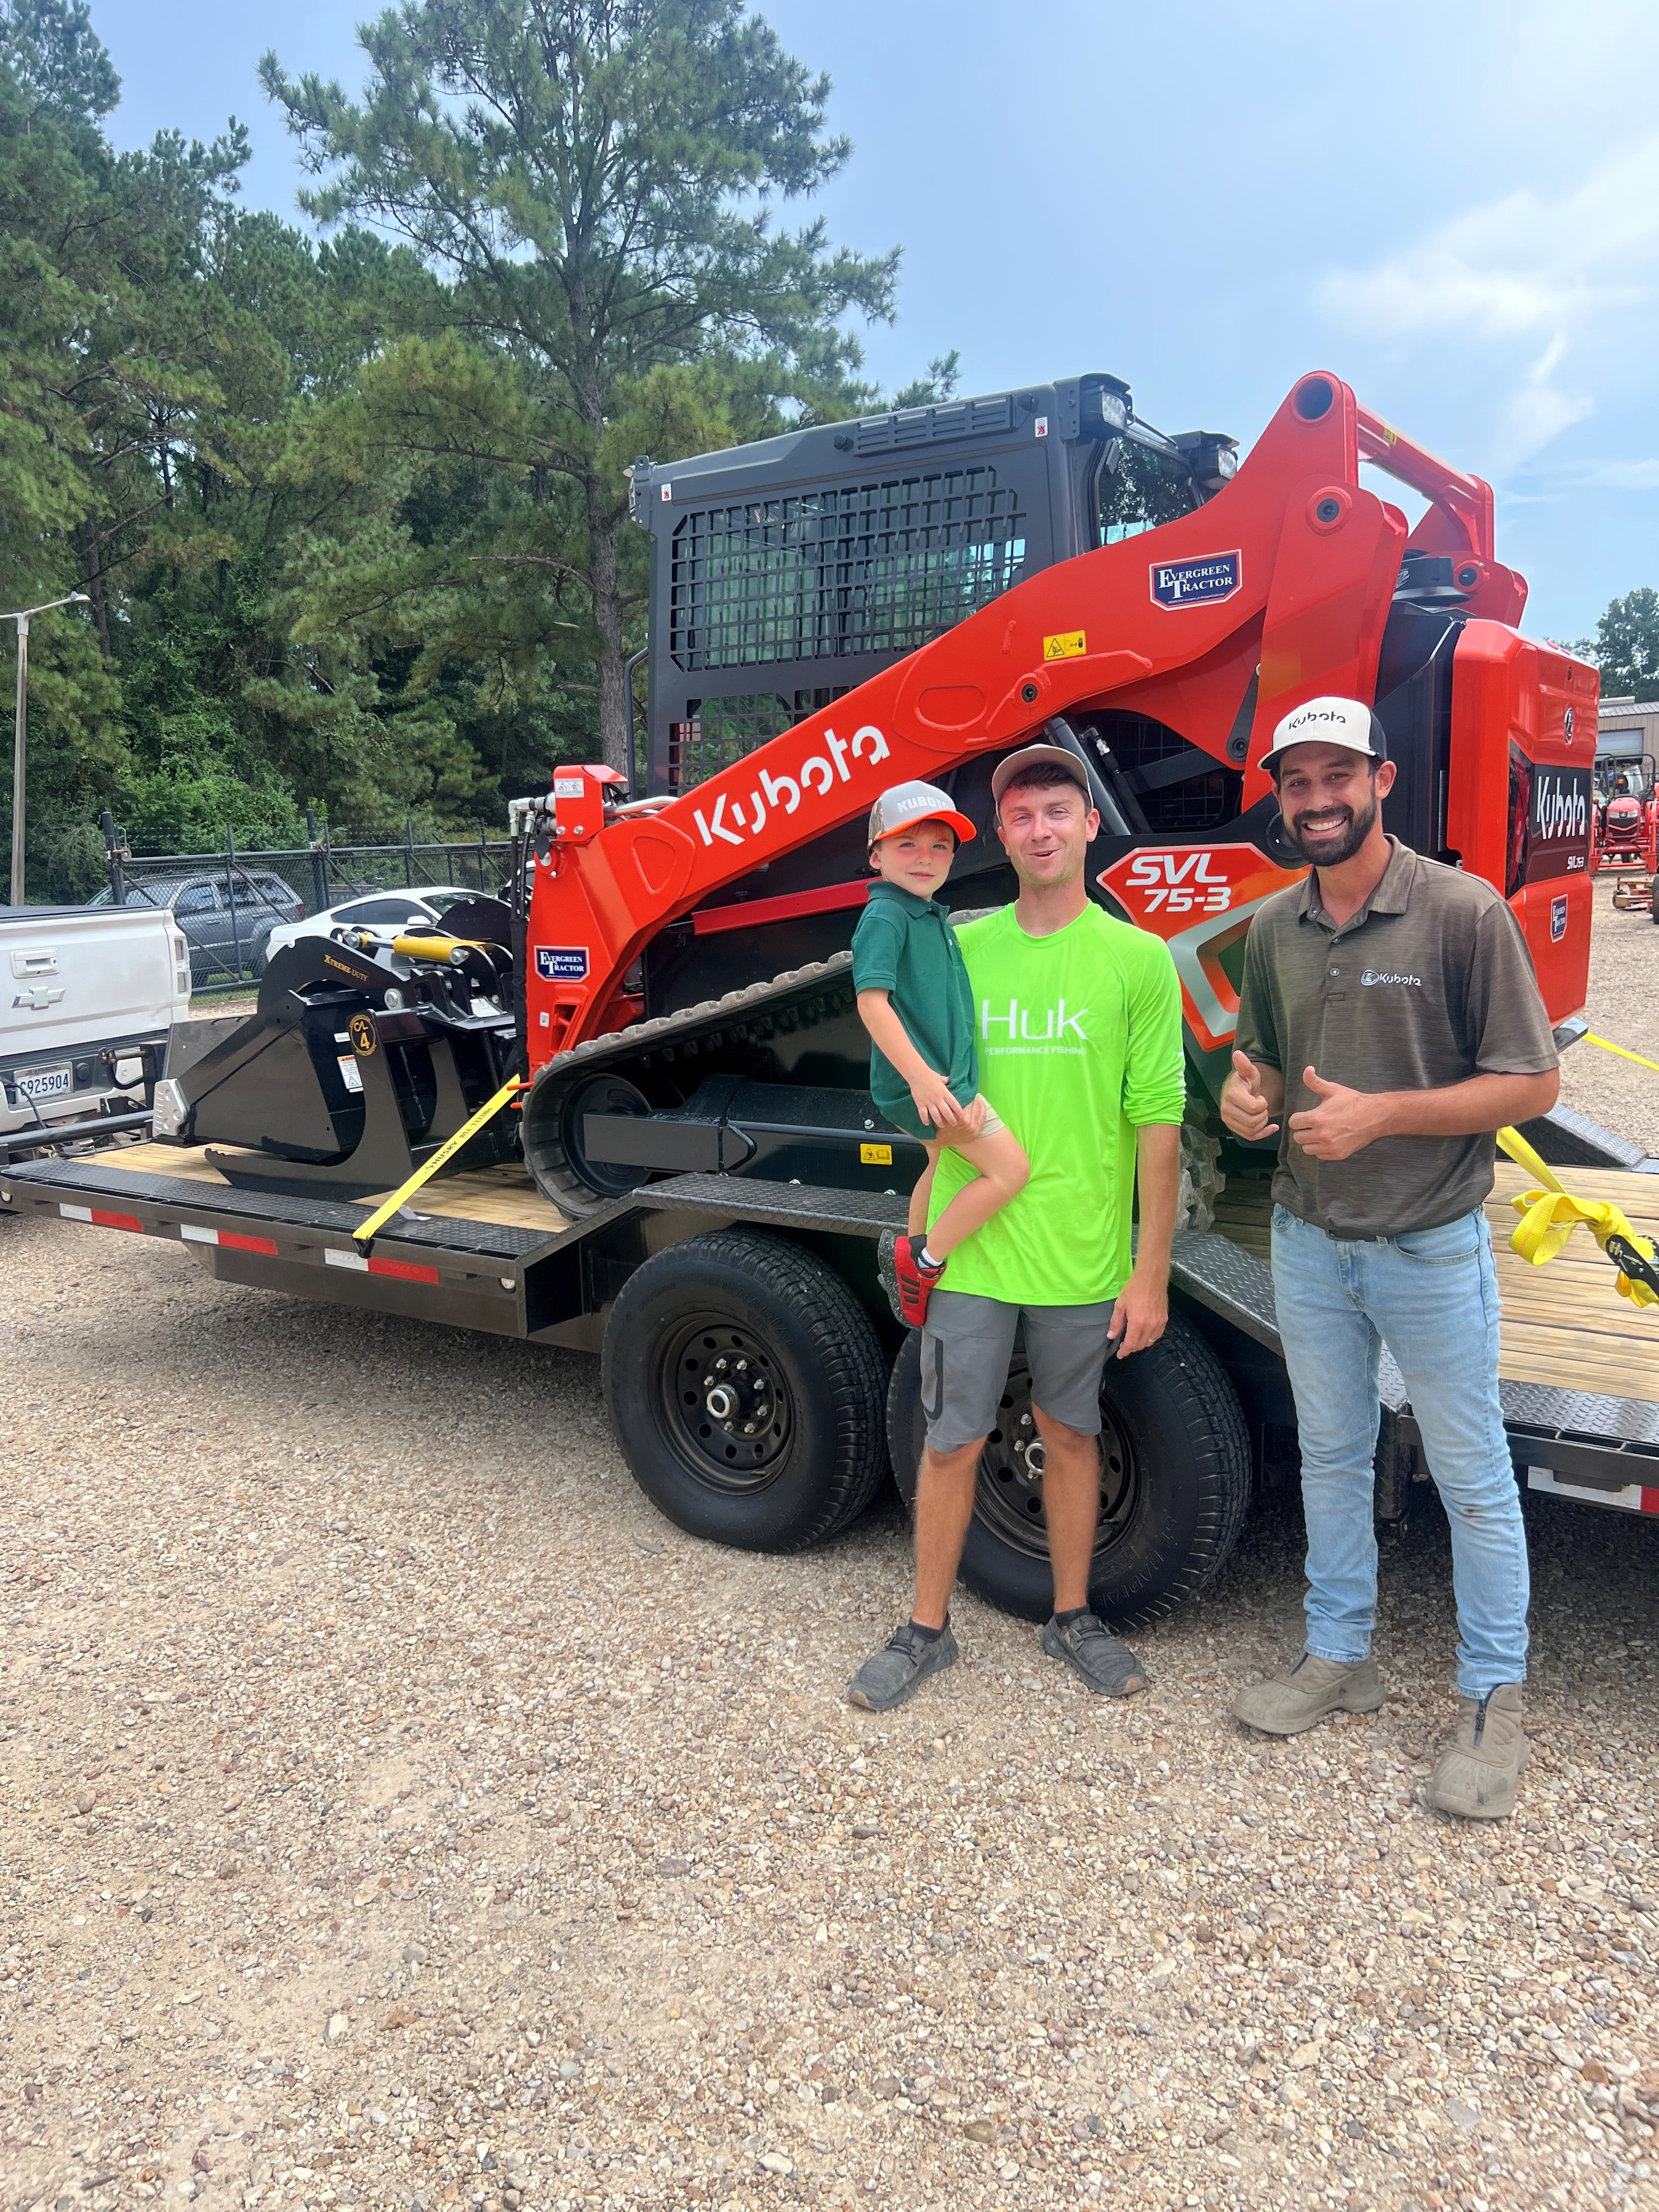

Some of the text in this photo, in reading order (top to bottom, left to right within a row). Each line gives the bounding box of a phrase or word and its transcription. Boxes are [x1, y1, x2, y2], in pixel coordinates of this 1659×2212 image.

[1158, 563, 1231, 589] EVERGREEN
[1172, 577, 1233, 599] TRACTOR
[1288, 711, 1346, 730] Kubota
[693, 725, 891, 847] Kubota
[896, 796, 949, 813] KUBOTA
[1537, 776, 1585, 840] Kubota
[1125, 853, 1228, 886] SVL
[1143, 887, 1232, 912] 75-3
[539, 951, 583, 966] EVERGREEN
[545, 961, 584, 974] TRACTOR
[1379, 973, 1422, 986] Kubota
[982, 998, 1088, 1040] Huk
[360, 1032, 370, 1049] 4
[985, 1046, 1086, 1056] PERFORMANCE FISHING
[432, 1141, 458, 1165] HUSKY
[736, 1287, 795, 1351] RADIAL
[1095, 1550, 1164, 1608] RADIAL
